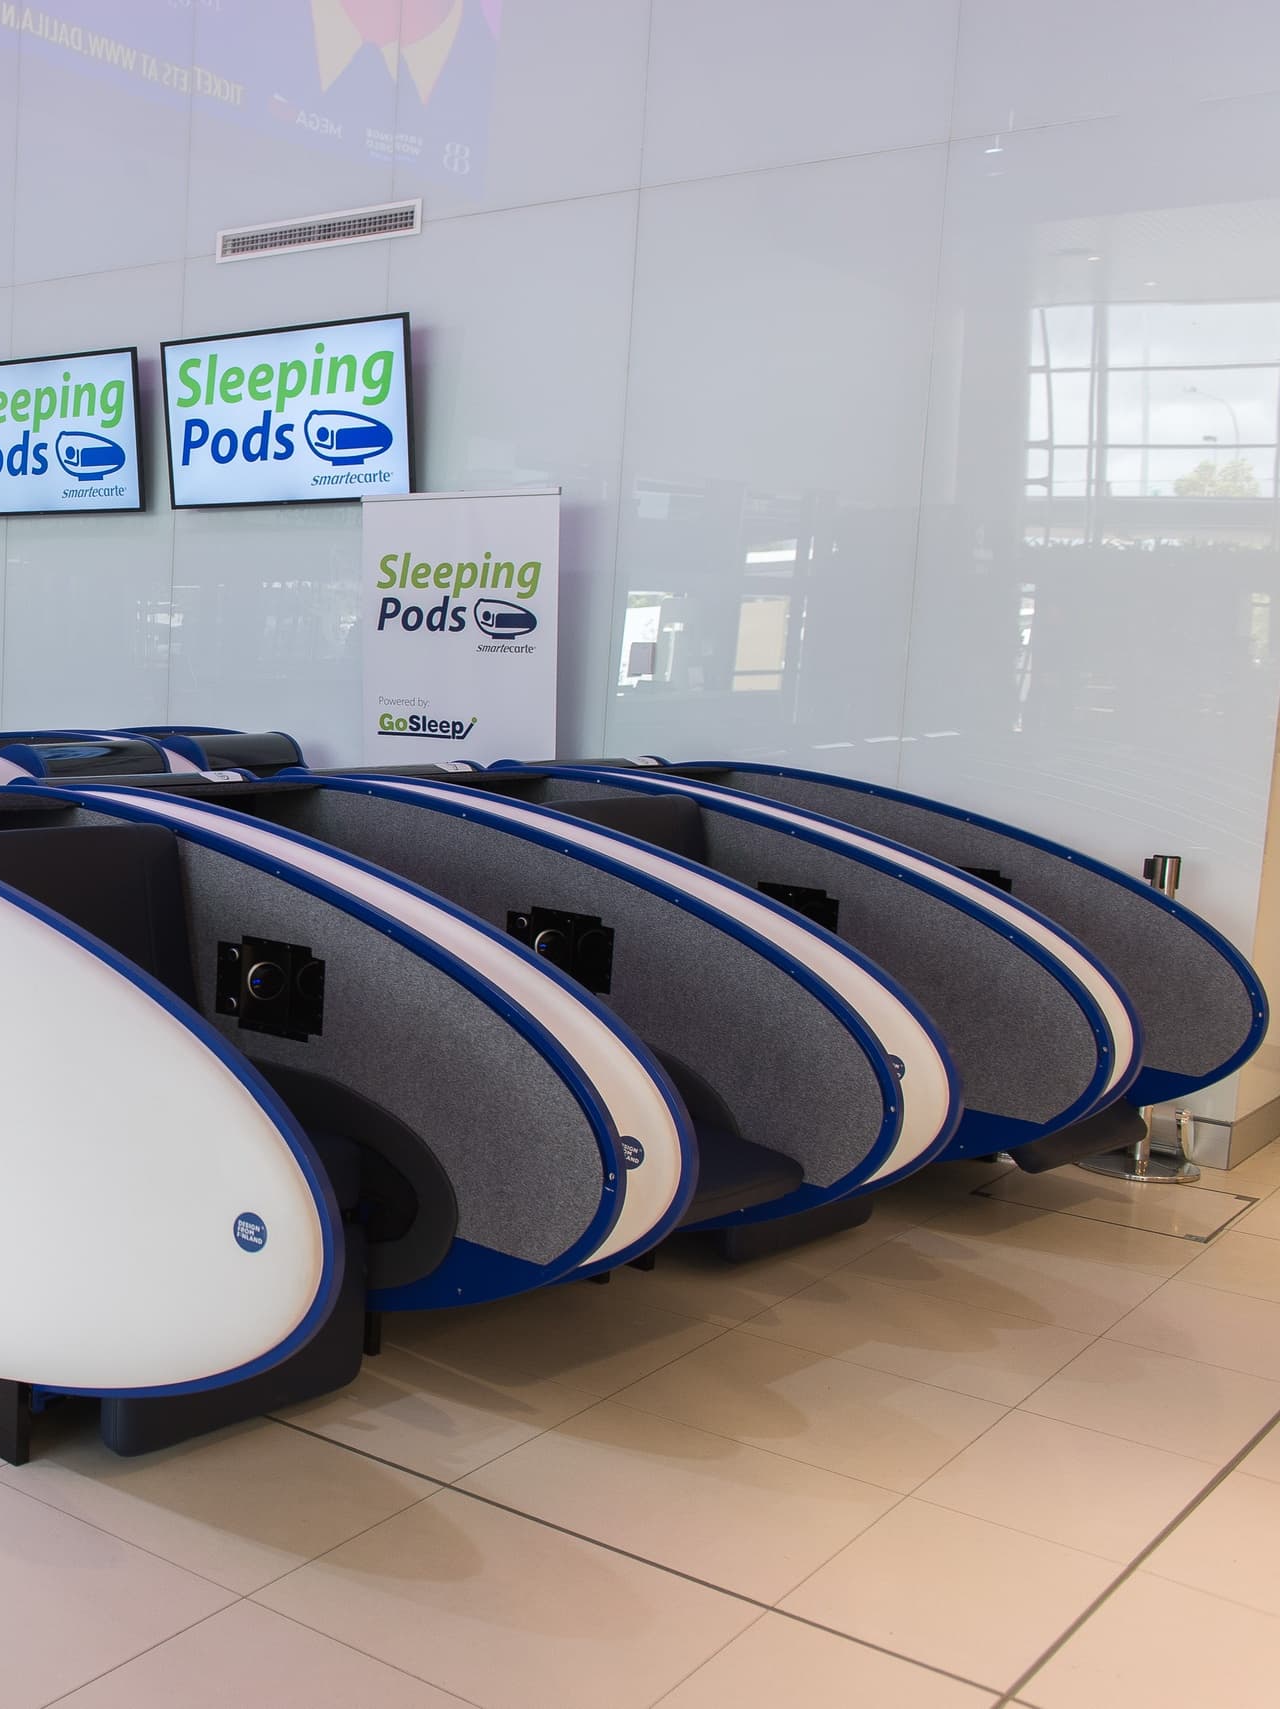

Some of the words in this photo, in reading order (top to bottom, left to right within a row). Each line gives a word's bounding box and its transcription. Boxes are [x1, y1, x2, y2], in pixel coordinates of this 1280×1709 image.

[176, 342, 394, 413] Sleeping
[181, 410, 295, 467] Pods
[61, 486, 124, 499] smartecarte
[310, 472, 391, 487] smartecarte
[376, 552, 541, 599] Sleeping
[377, 596, 467, 632] Pods
[476, 644, 534, 653] smartecarte
[378, 695, 416, 707] Powered
[418, 697, 430, 708] by:
[379, 713, 464, 739] GoSleep
